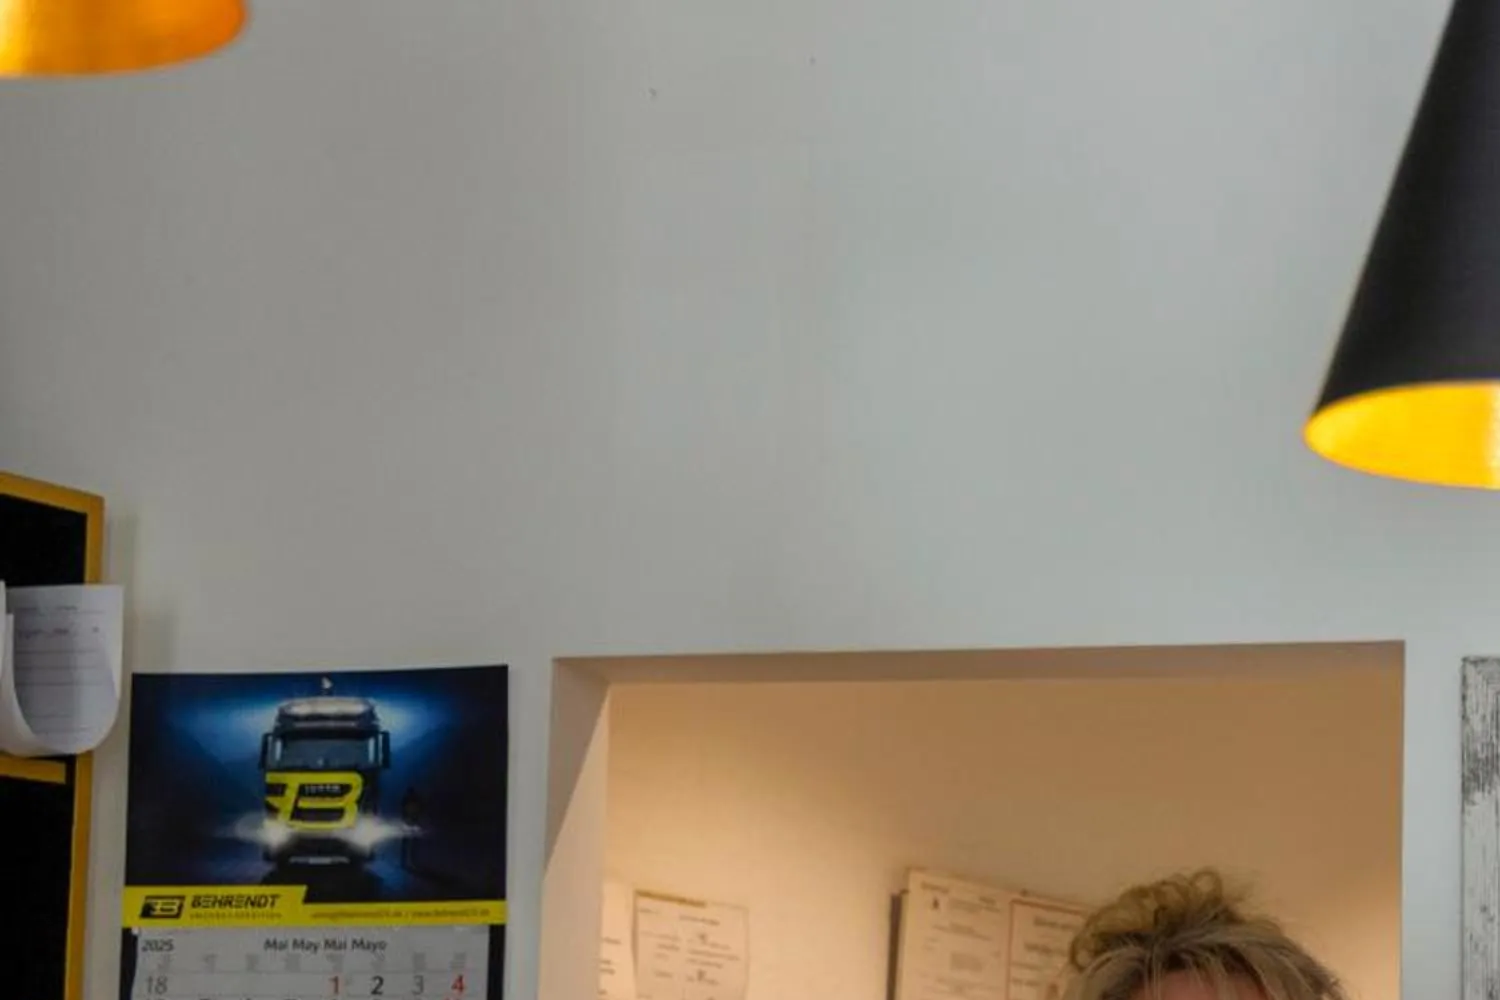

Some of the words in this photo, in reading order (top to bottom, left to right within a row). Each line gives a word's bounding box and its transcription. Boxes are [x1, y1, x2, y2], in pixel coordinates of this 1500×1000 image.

[190, 894, 280, 910] BEHRENDT
[142, 939, 174, 952] 2025
[292, 937, 318, 954] May
[146, 976, 168, 994] 18
[330, 976, 340, 994] 1
[370, 976, 384, 996] 2
[412, 976, 424, 996] 3
[452, 974, 464, 992] 4
